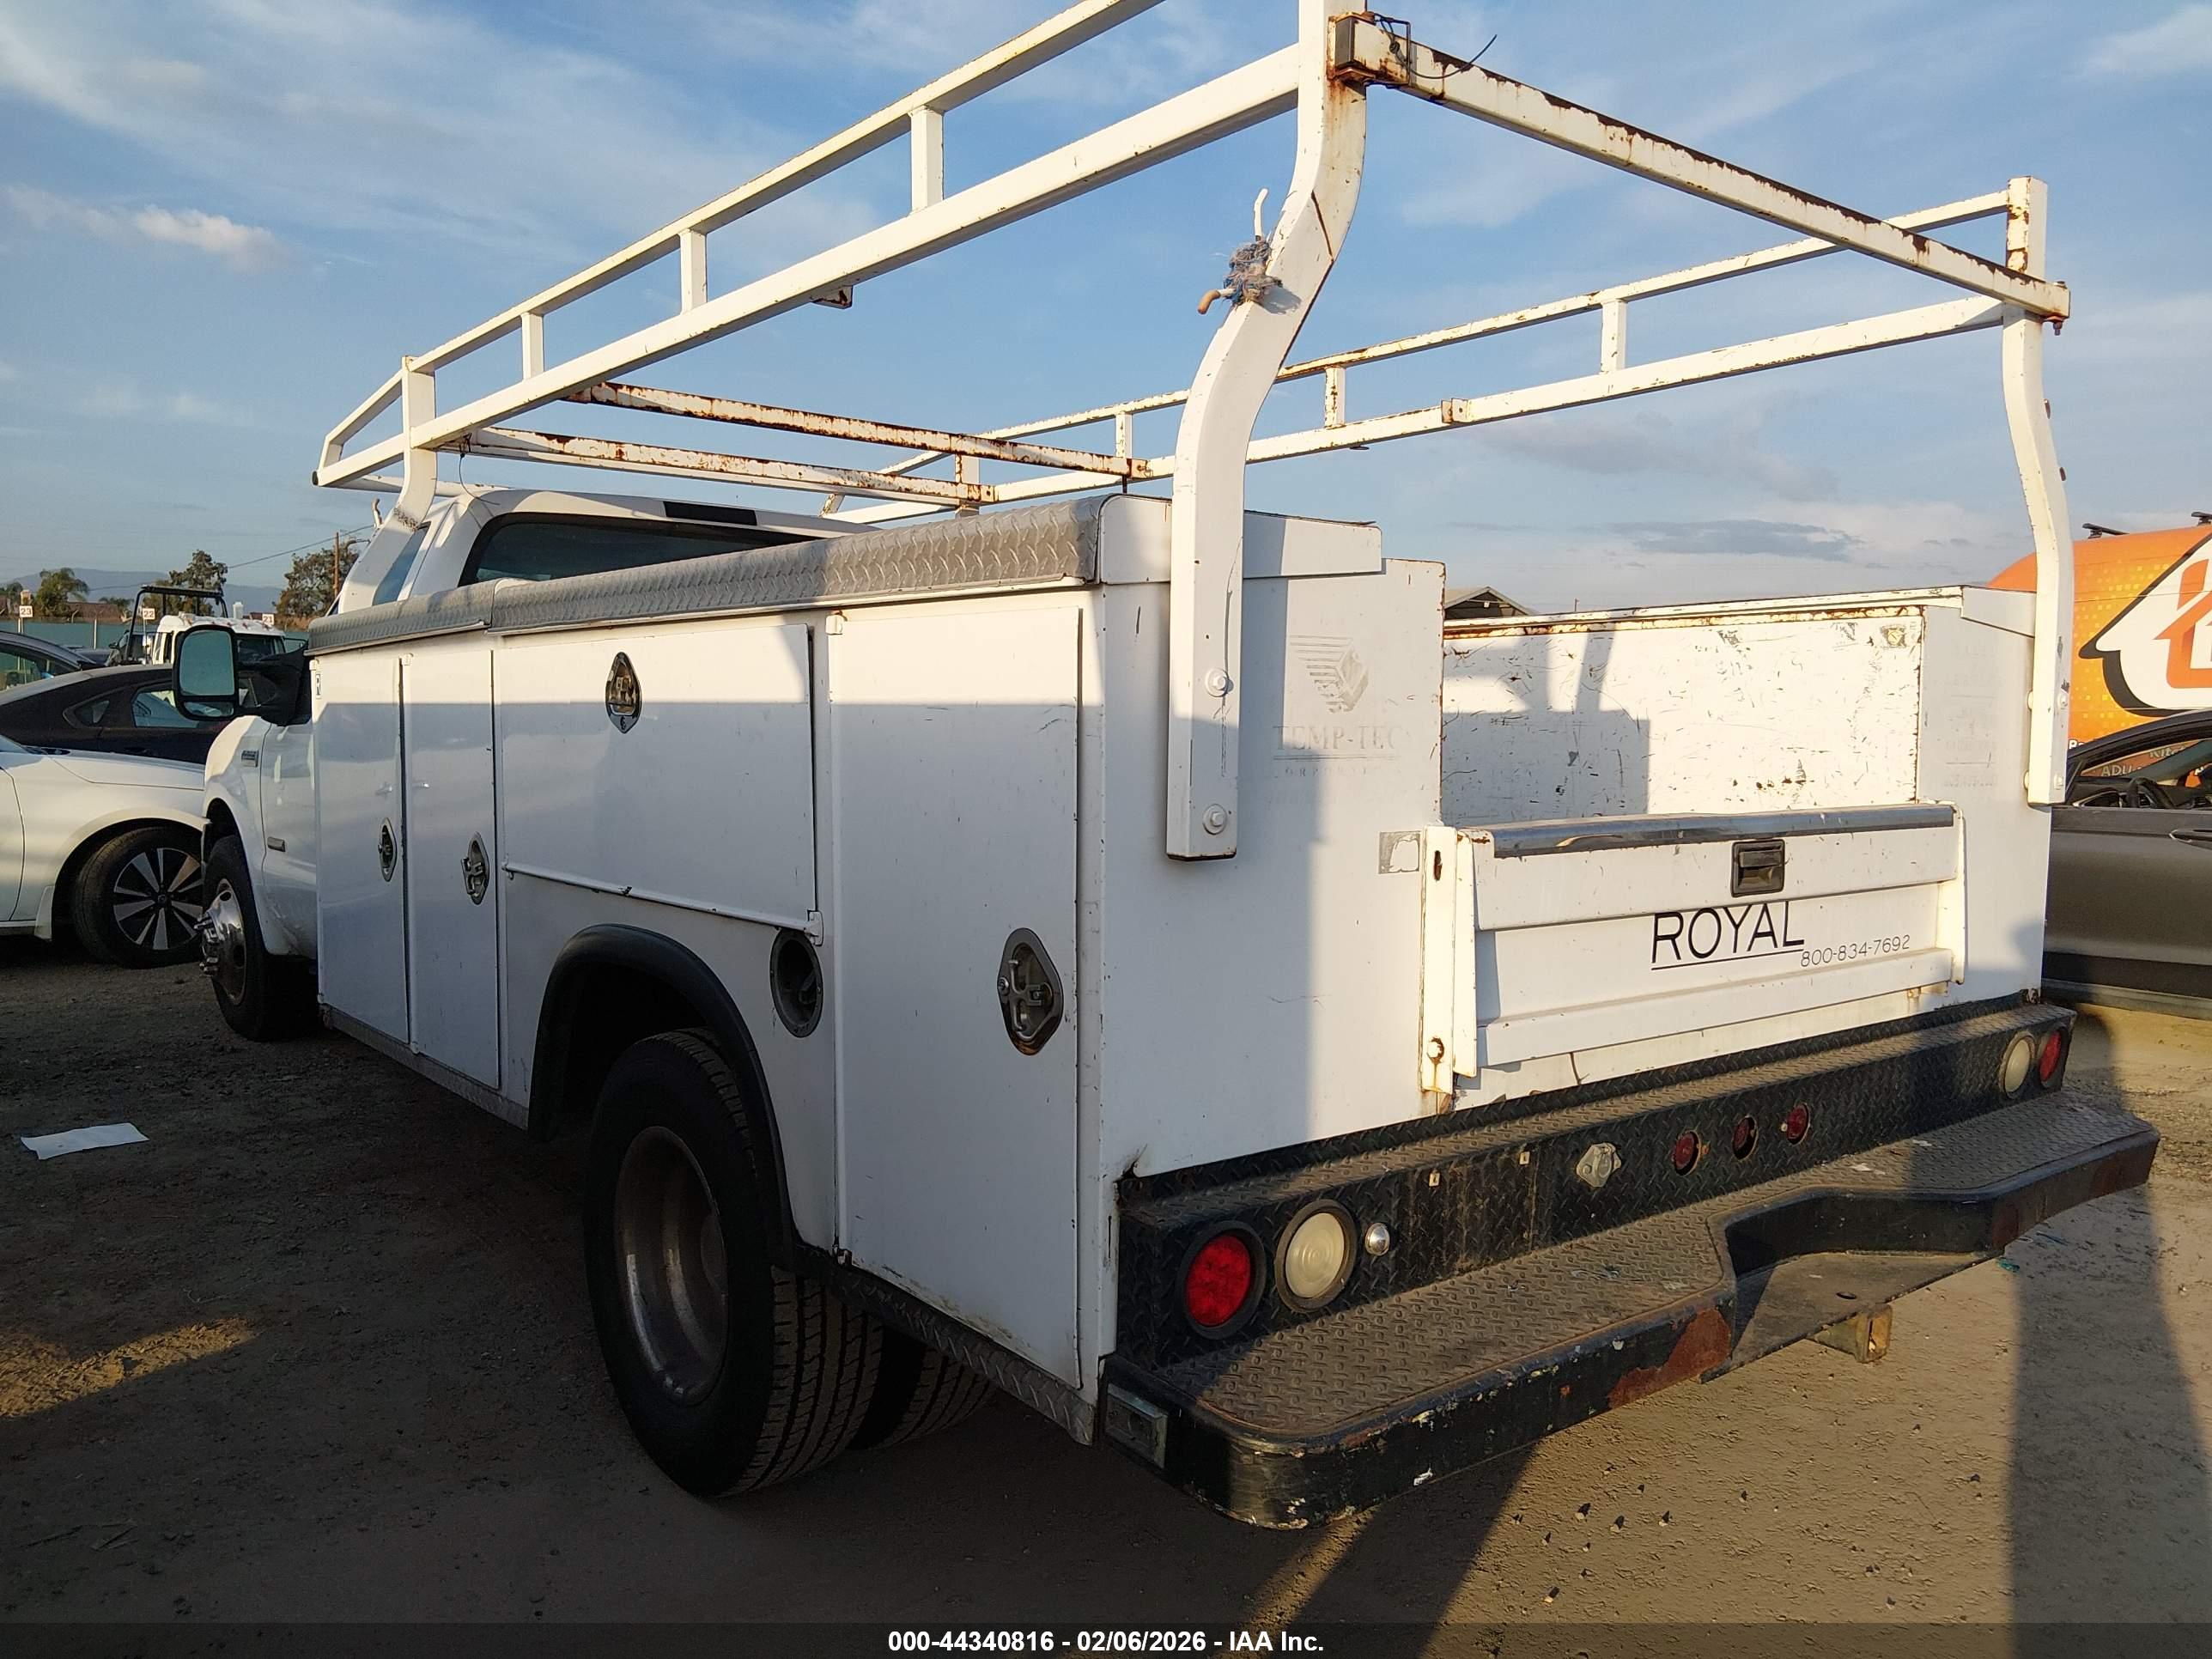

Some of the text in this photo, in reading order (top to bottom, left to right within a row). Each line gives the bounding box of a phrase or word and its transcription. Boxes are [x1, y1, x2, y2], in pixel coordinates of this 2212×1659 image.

[21, 607, 32, 616] 23
[1651, 901, 1805, 963] ROYAL
[1801, 934, 1911, 968] 800-834-7692
